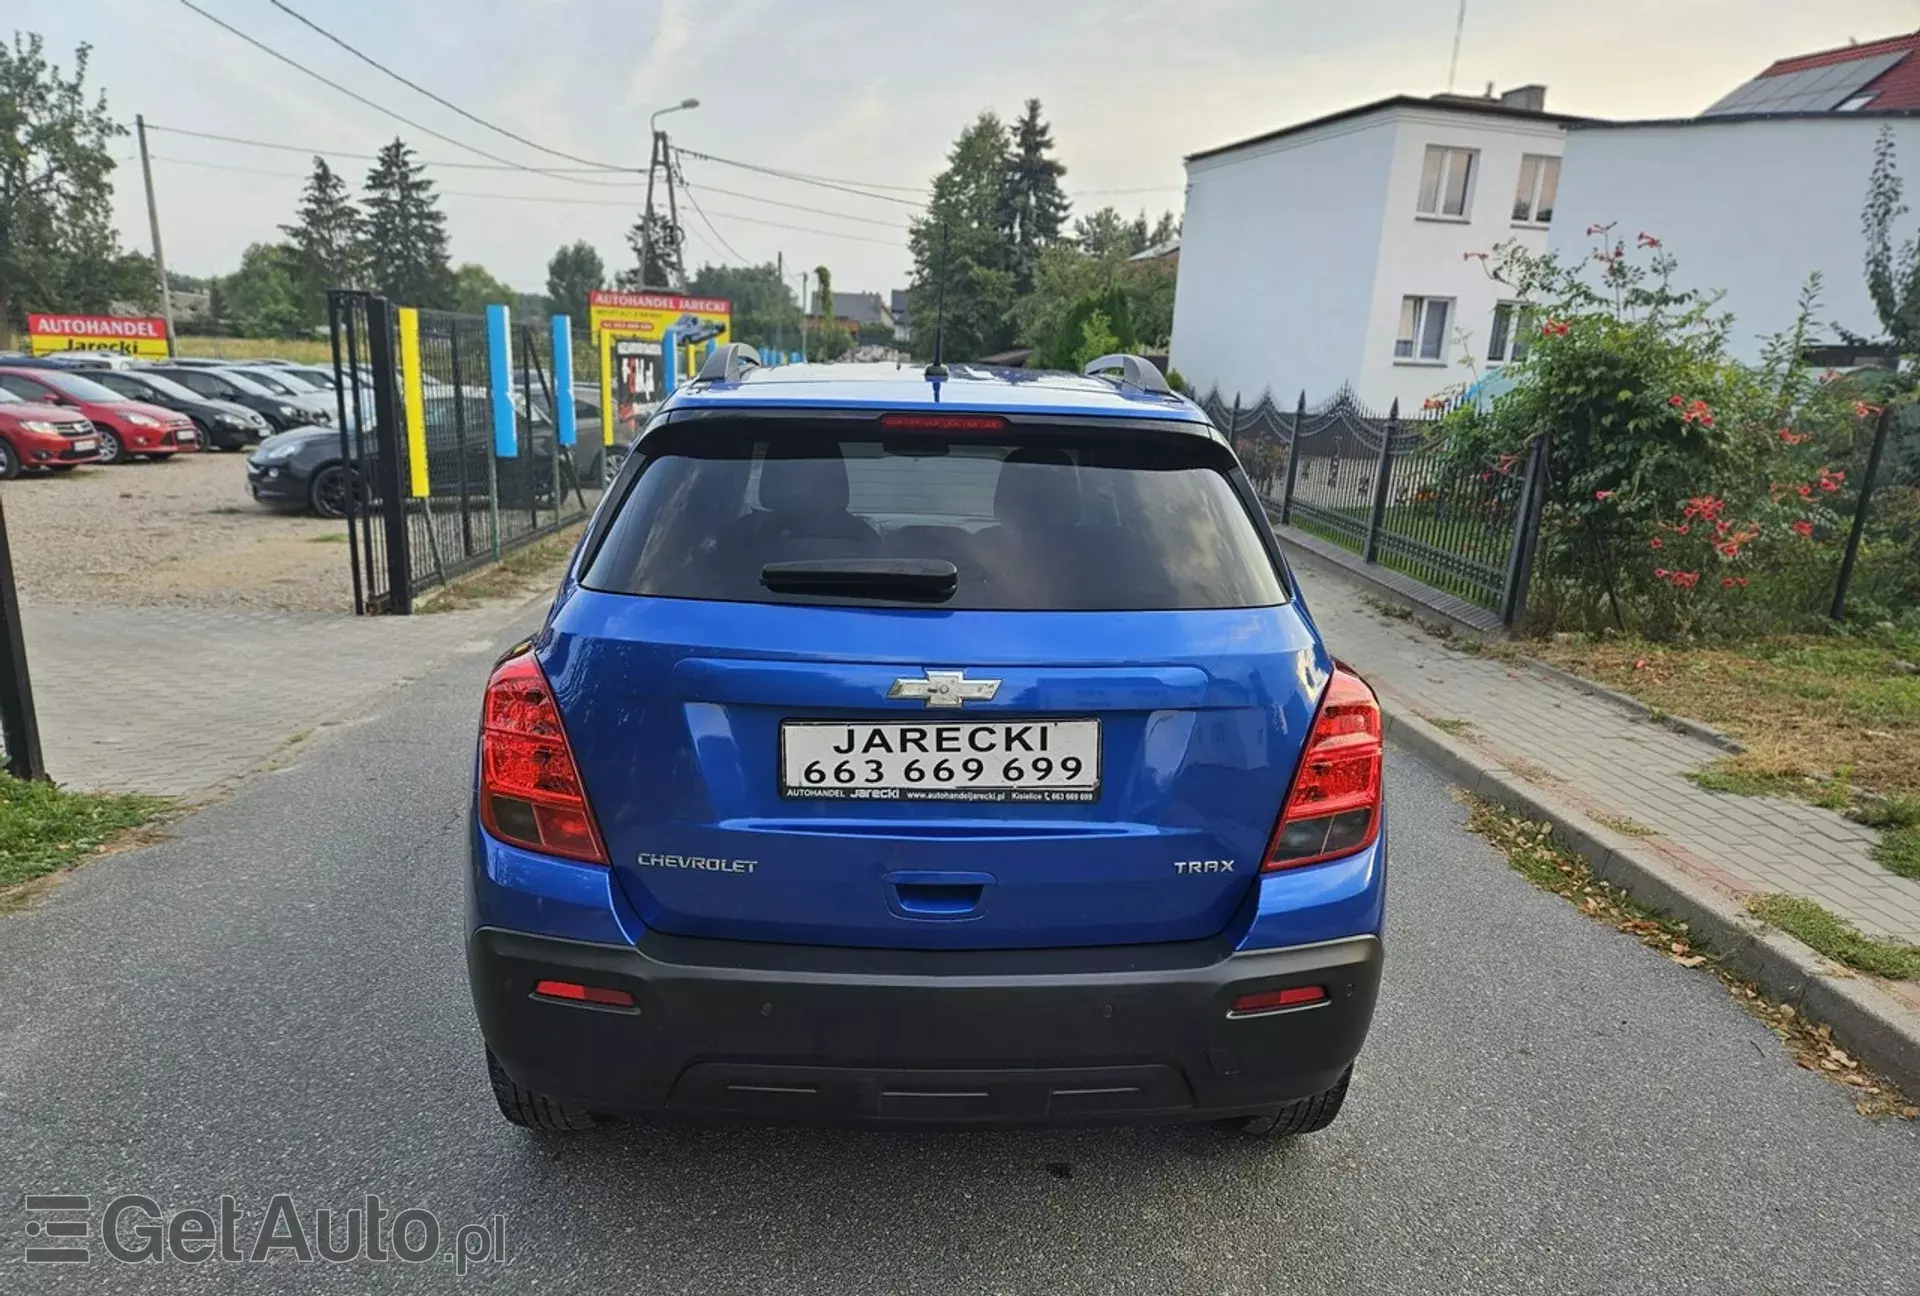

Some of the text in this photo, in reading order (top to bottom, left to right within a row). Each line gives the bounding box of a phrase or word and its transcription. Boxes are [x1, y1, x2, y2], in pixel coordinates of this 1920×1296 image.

[595, 294, 725, 312] AUTOHANDEL JARECKI
[38, 318, 158, 337] AUTOHANDEL
[65, 339, 138, 355] Jarecki
[833, 726, 1048, 754] JARECKI
[804, 756, 1083, 784] 663 669 699
[786, 789, 845, 797] AUTOHANDEL
[851, 788, 900, 798] Jarecki
[906, 791, 1005, 801] www.autohandeljarecki.pl
[1011, 792, 1042, 800] Kisielice
[1051, 792, 1065, 800] 663
[637, 853, 758, 873] CHEVROLET
[1174, 860, 1235, 874] TRAX
